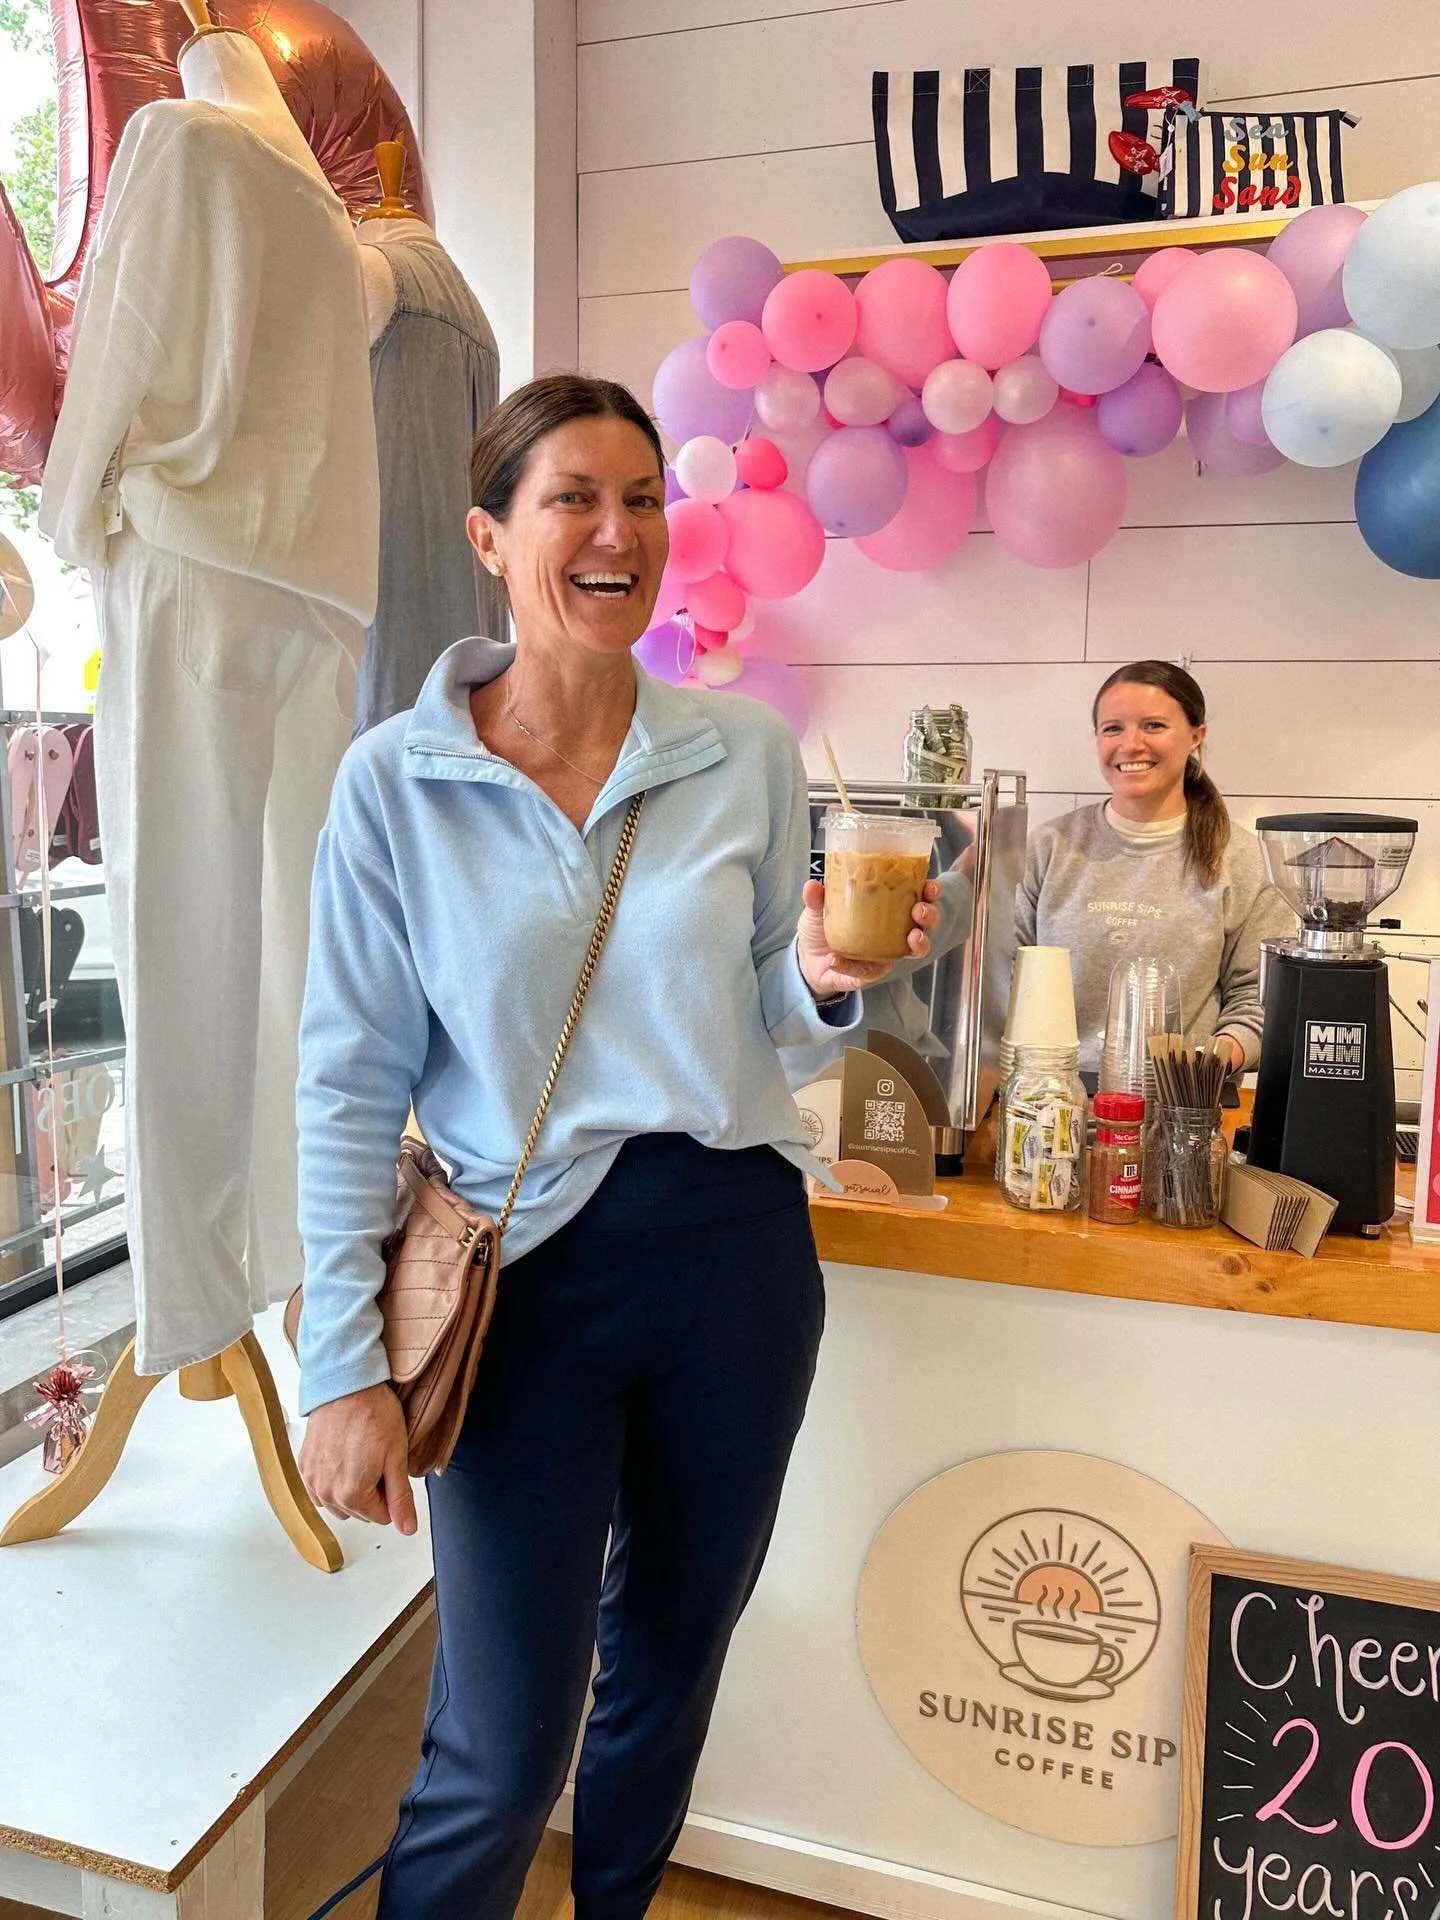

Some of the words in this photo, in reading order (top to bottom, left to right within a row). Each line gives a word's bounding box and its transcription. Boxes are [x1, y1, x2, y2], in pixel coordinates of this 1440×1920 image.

[1224, 117, 1289, 141] Sea
[1222, 144, 1294, 173] Sun
[1213, 176, 1302, 209] Sand
[1087, 901, 1136, 913] SUNRISE
[1137, 903, 1162, 919] SIPS
[1308, 1066, 1360, 1076] MAZZER
[918, 1689, 1094, 1751] SUNRISE
[1110, 1729, 1178, 1767] SIP
[994, 1747, 1114, 1790] COFFEE
[1255, 1718, 1434, 1850] 20
